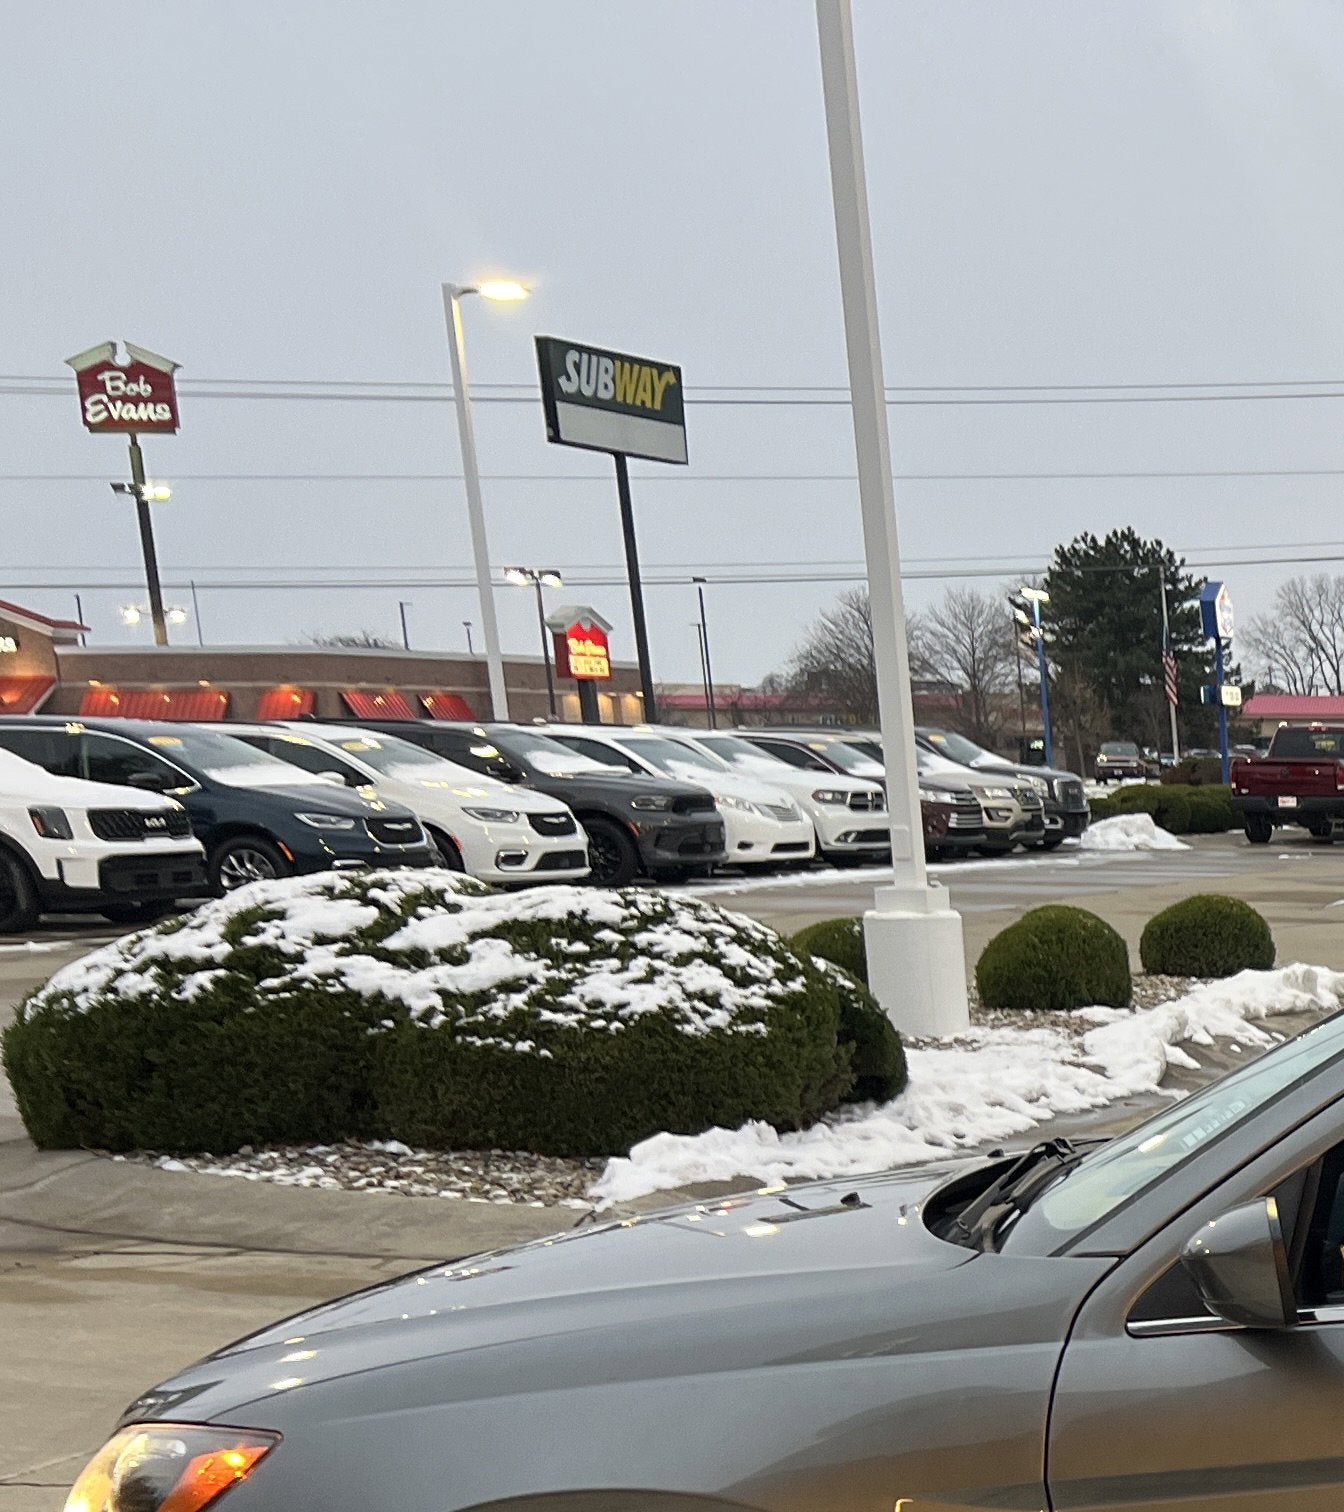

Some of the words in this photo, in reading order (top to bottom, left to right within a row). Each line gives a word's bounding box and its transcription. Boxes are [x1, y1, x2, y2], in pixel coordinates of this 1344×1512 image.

[97, 371, 153, 398] Bob
[558, 350, 677, 411] SUBWAY
[85, 393, 173, 424] Evans
